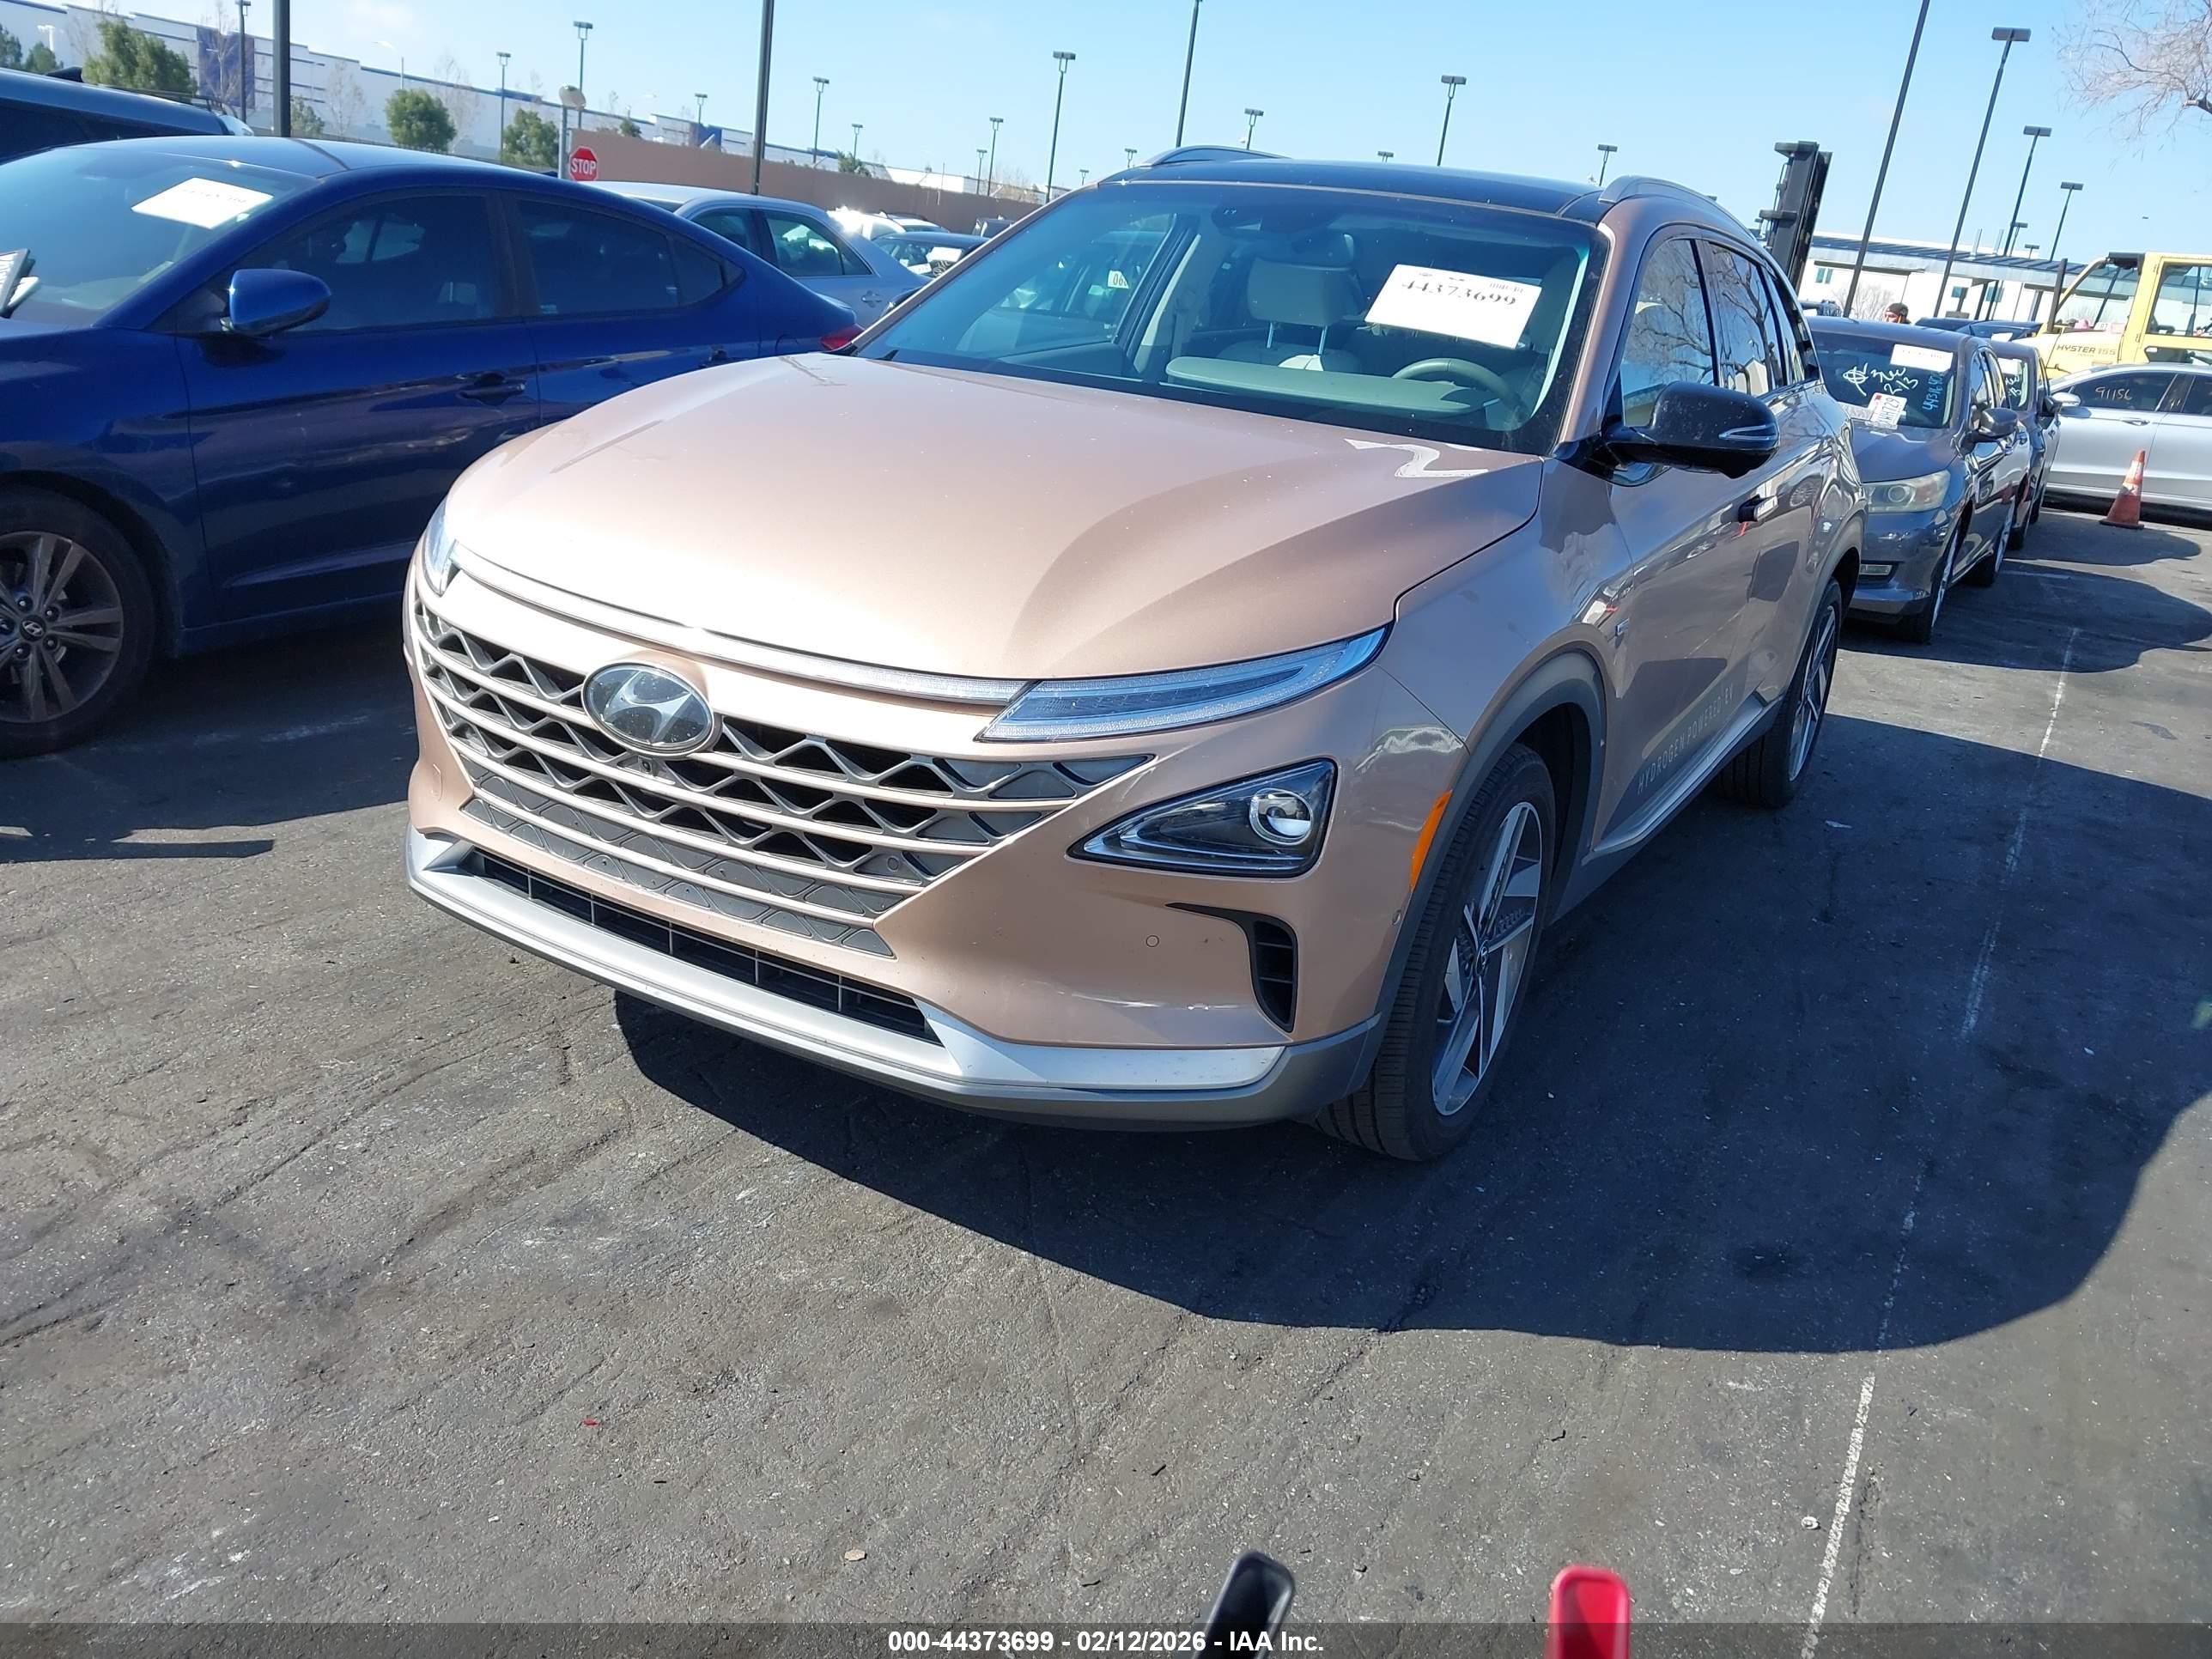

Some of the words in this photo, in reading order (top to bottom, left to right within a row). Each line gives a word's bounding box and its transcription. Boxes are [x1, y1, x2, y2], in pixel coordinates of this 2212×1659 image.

[571, 157, 597, 175] STOP
[2057, 344, 2096, 354] HYSTER
[1638, 733, 1685, 794] HYDROGEN
[1686, 696, 1722, 745] POWERED
